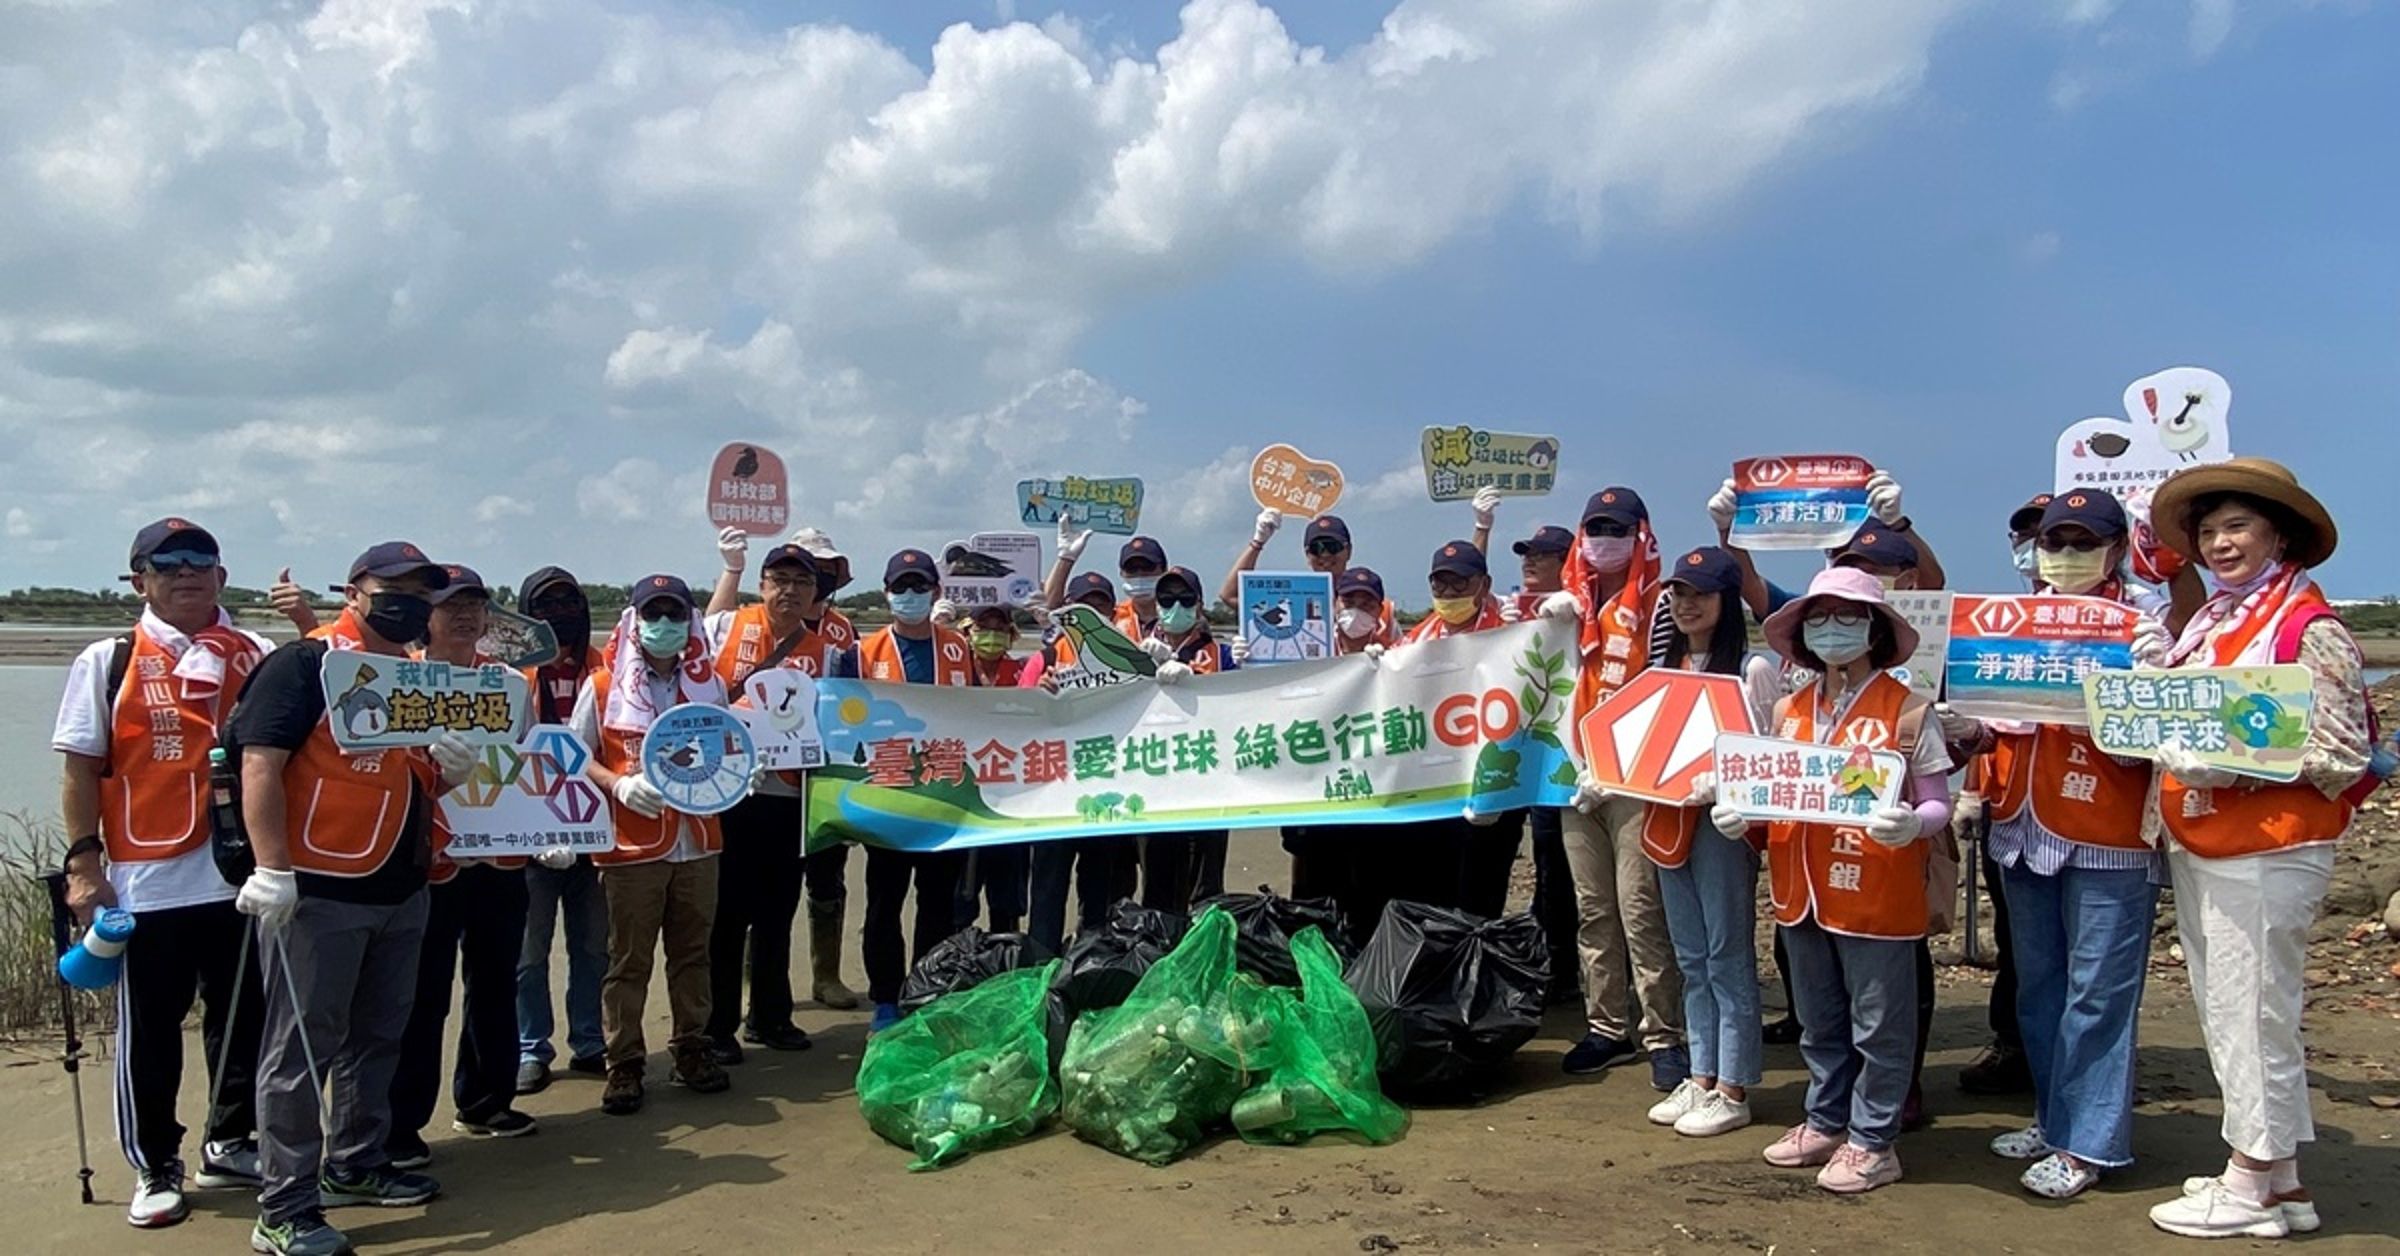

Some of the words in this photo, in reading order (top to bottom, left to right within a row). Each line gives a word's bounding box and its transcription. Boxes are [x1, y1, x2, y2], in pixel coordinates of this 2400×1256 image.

[1262, 456, 1297, 481] 台灣
[721, 480, 777, 501] 財政部
[1255, 474, 1323, 512] 中小企銀
[1755, 501, 1846, 524] 淨灘活動
[2033, 604, 2126, 626] 臺灣企銀
[396, 662, 506, 689] 我們一起
[1975, 652, 2103, 685] 淨灘活動
[2097, 675, 2224, 712] 綠色行動
[388, 689, 514, 734] 撿垃圾
[868, 727, 1219, 788] 臺灣企銀愛地球
[1234, 705, 1427, 771] 綠色行動
[1433, 688, 1520, 747] GO
[2102, 715, 2227, 751] 永續未來
[1828, 826, 1866, 893] 企銀
